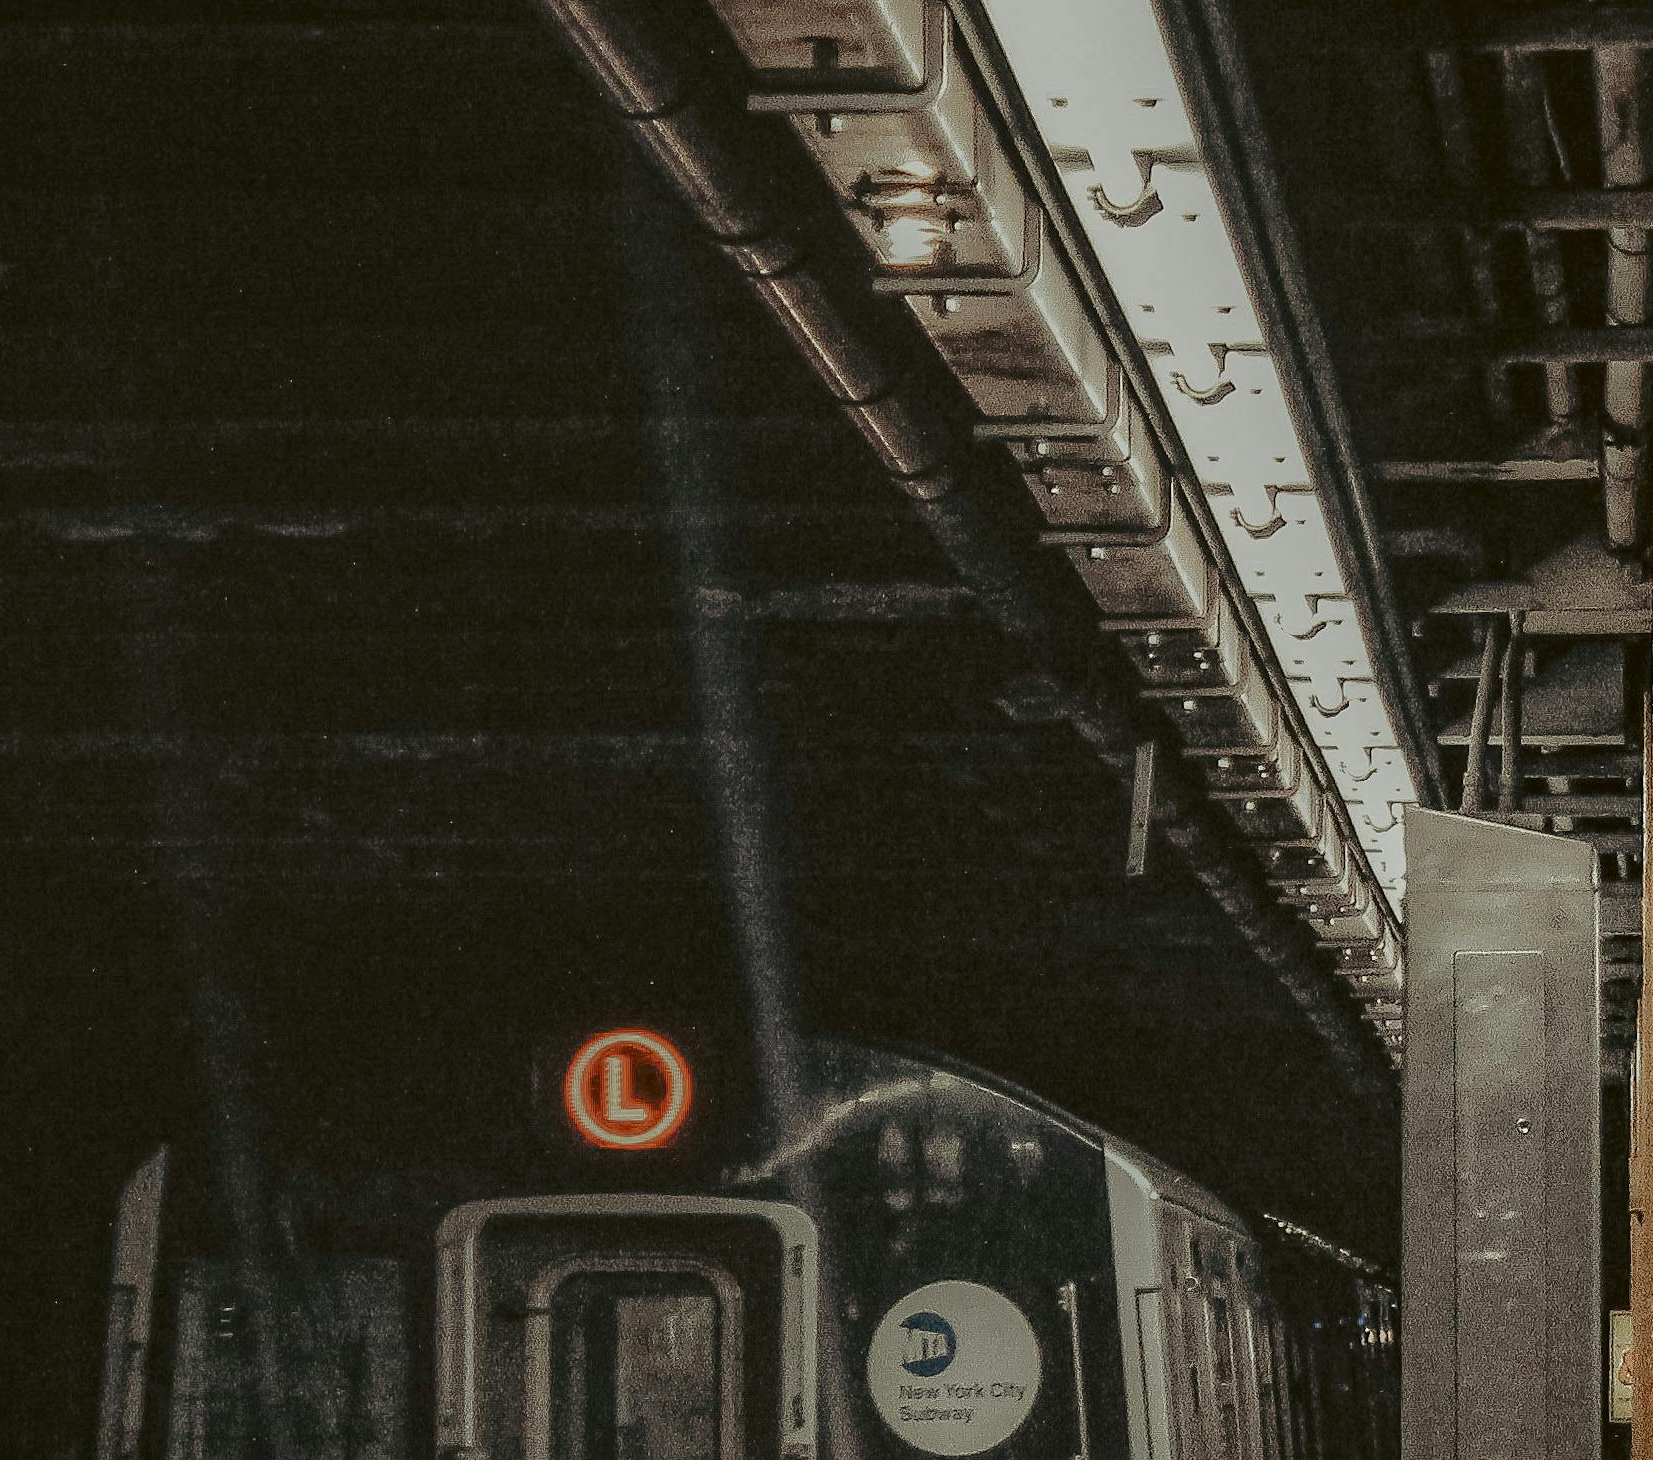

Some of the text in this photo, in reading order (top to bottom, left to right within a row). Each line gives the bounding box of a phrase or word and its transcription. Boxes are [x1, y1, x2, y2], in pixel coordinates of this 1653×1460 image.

[898, 1382, 1026, 1401] New York City
[899, 1405, 975, 1424] Subway
